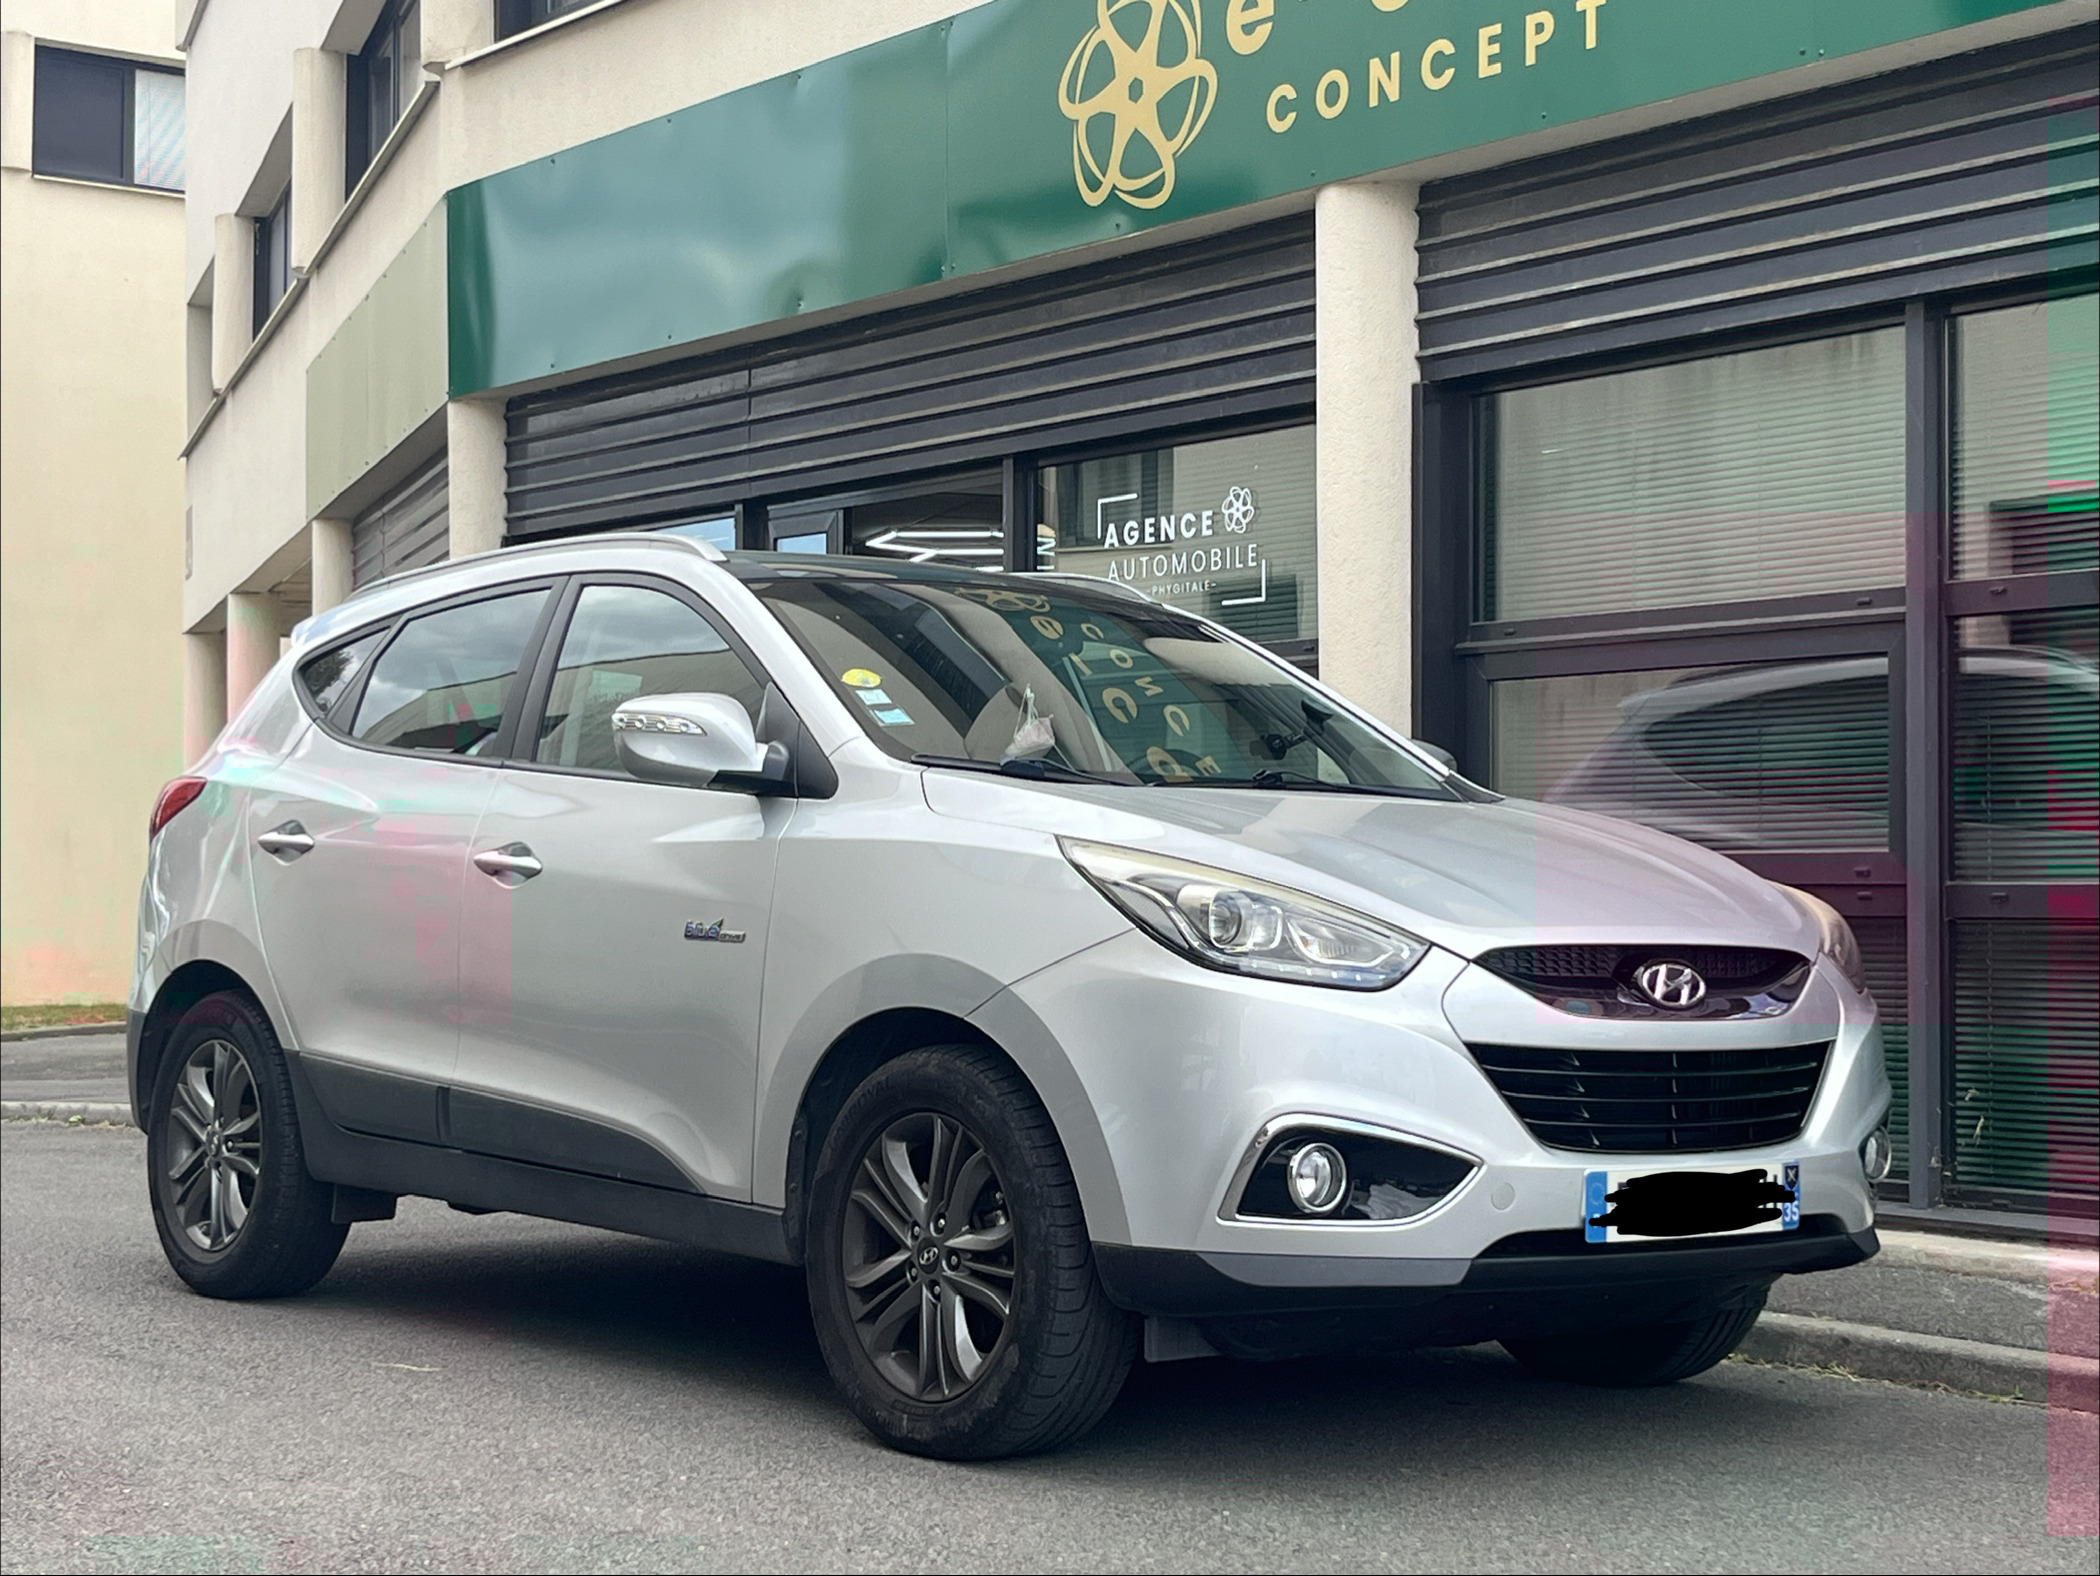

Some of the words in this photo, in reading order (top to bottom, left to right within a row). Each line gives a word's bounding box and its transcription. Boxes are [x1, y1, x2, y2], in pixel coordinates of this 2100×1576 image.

[1266, 0, 1606, 133] CONCEPT
[1103, 510, 1214, 549] AGENCE
[1107, 543, 1258, 581] AUTOMOBILE
[1783, 1201, 1800, 1222] 35
